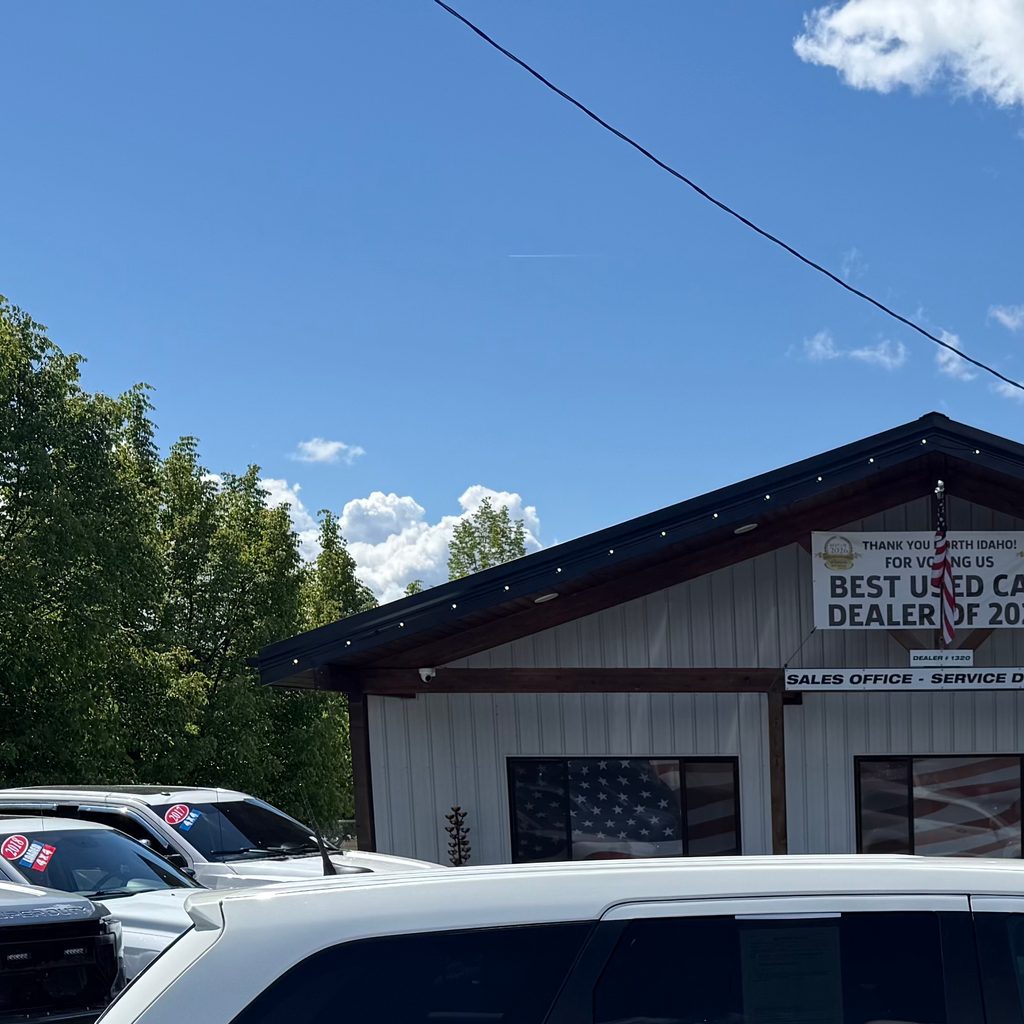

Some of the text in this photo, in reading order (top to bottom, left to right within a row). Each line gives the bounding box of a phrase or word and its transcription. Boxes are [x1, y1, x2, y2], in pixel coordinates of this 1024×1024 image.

[862, 540, 904, 551] THANK
[906, 540, 930, 550] YOU
[976, 539, 1017, 550] IDAHO!
[885, 556, 995, 569] FOR VONG US
[830, 575, 902, 599] BEST
[828, 603, 936, 627] DEALER
[786, 674, 845, 685] SALES
[849, 673, 913, 684] OFFICE
[930, 672, 1007, 684] SERVICE
[169, 806, 185, 822] 2017
[4, 836, 25, 857] 2018
